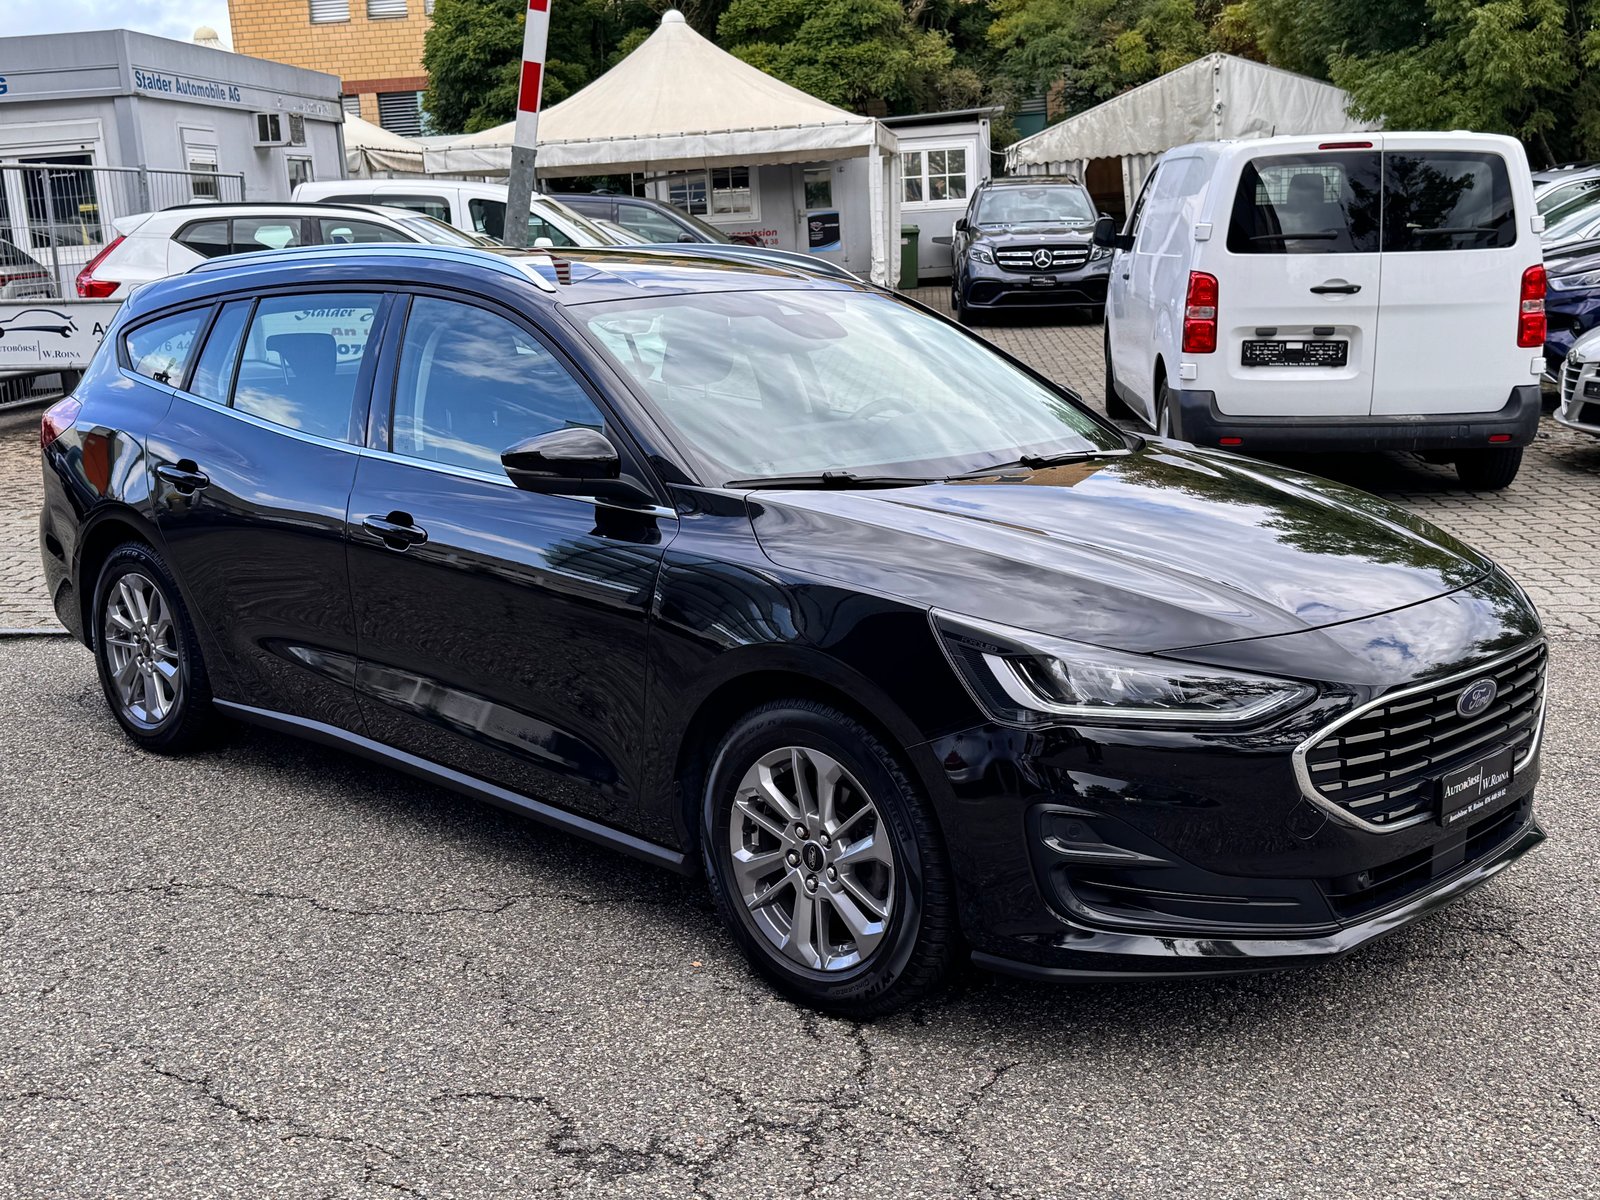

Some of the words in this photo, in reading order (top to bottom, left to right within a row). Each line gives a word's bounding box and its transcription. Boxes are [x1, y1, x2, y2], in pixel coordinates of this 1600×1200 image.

[134, 70, 172, 92] Stalder
[176, 77, 226, 100] Automobile
[229, 86, 241, 102] AG
[1469, 687, 1491, 710] Ford
